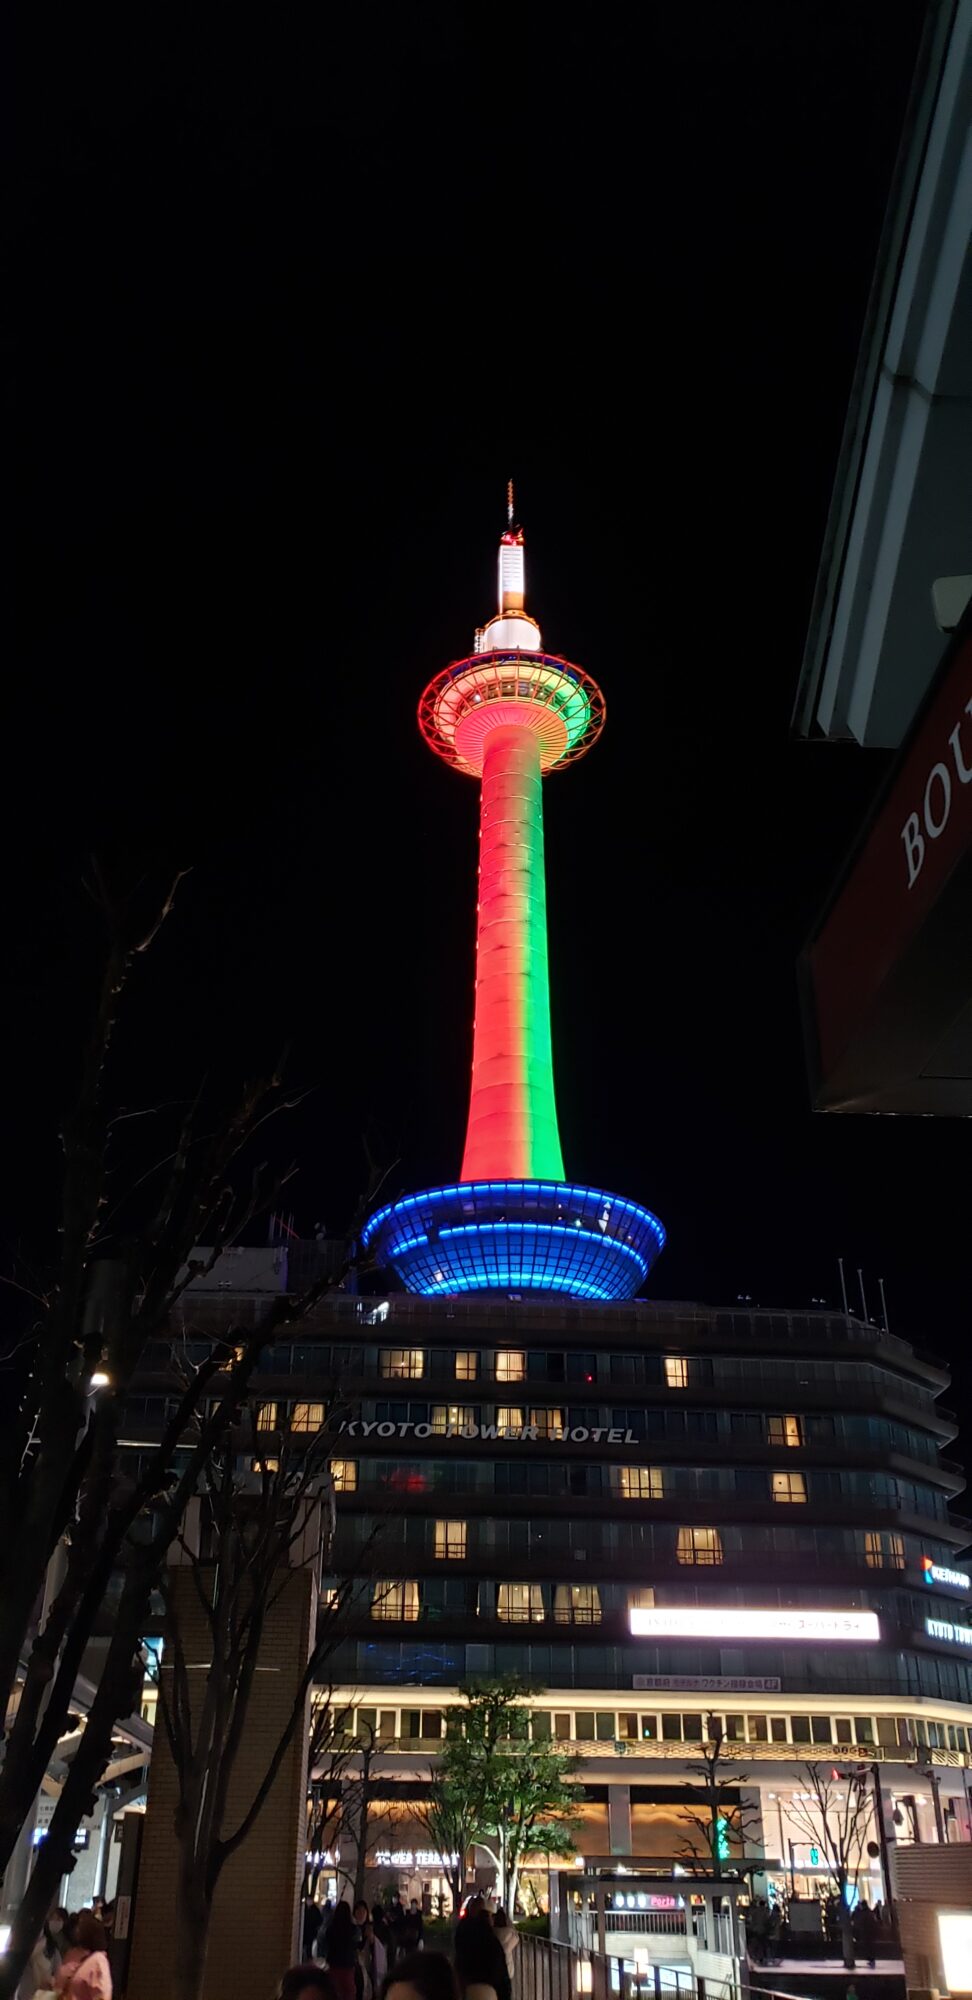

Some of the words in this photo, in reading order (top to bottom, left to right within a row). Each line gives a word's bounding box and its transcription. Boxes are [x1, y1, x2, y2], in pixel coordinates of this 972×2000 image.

[338, 1420, 433, 1438] KYOTO
[446, 1422, 538, 1441] TOWER
[550, 1425, 640, 1444] HOTEL
[927, 1618, 954, 1640] KYOTO
